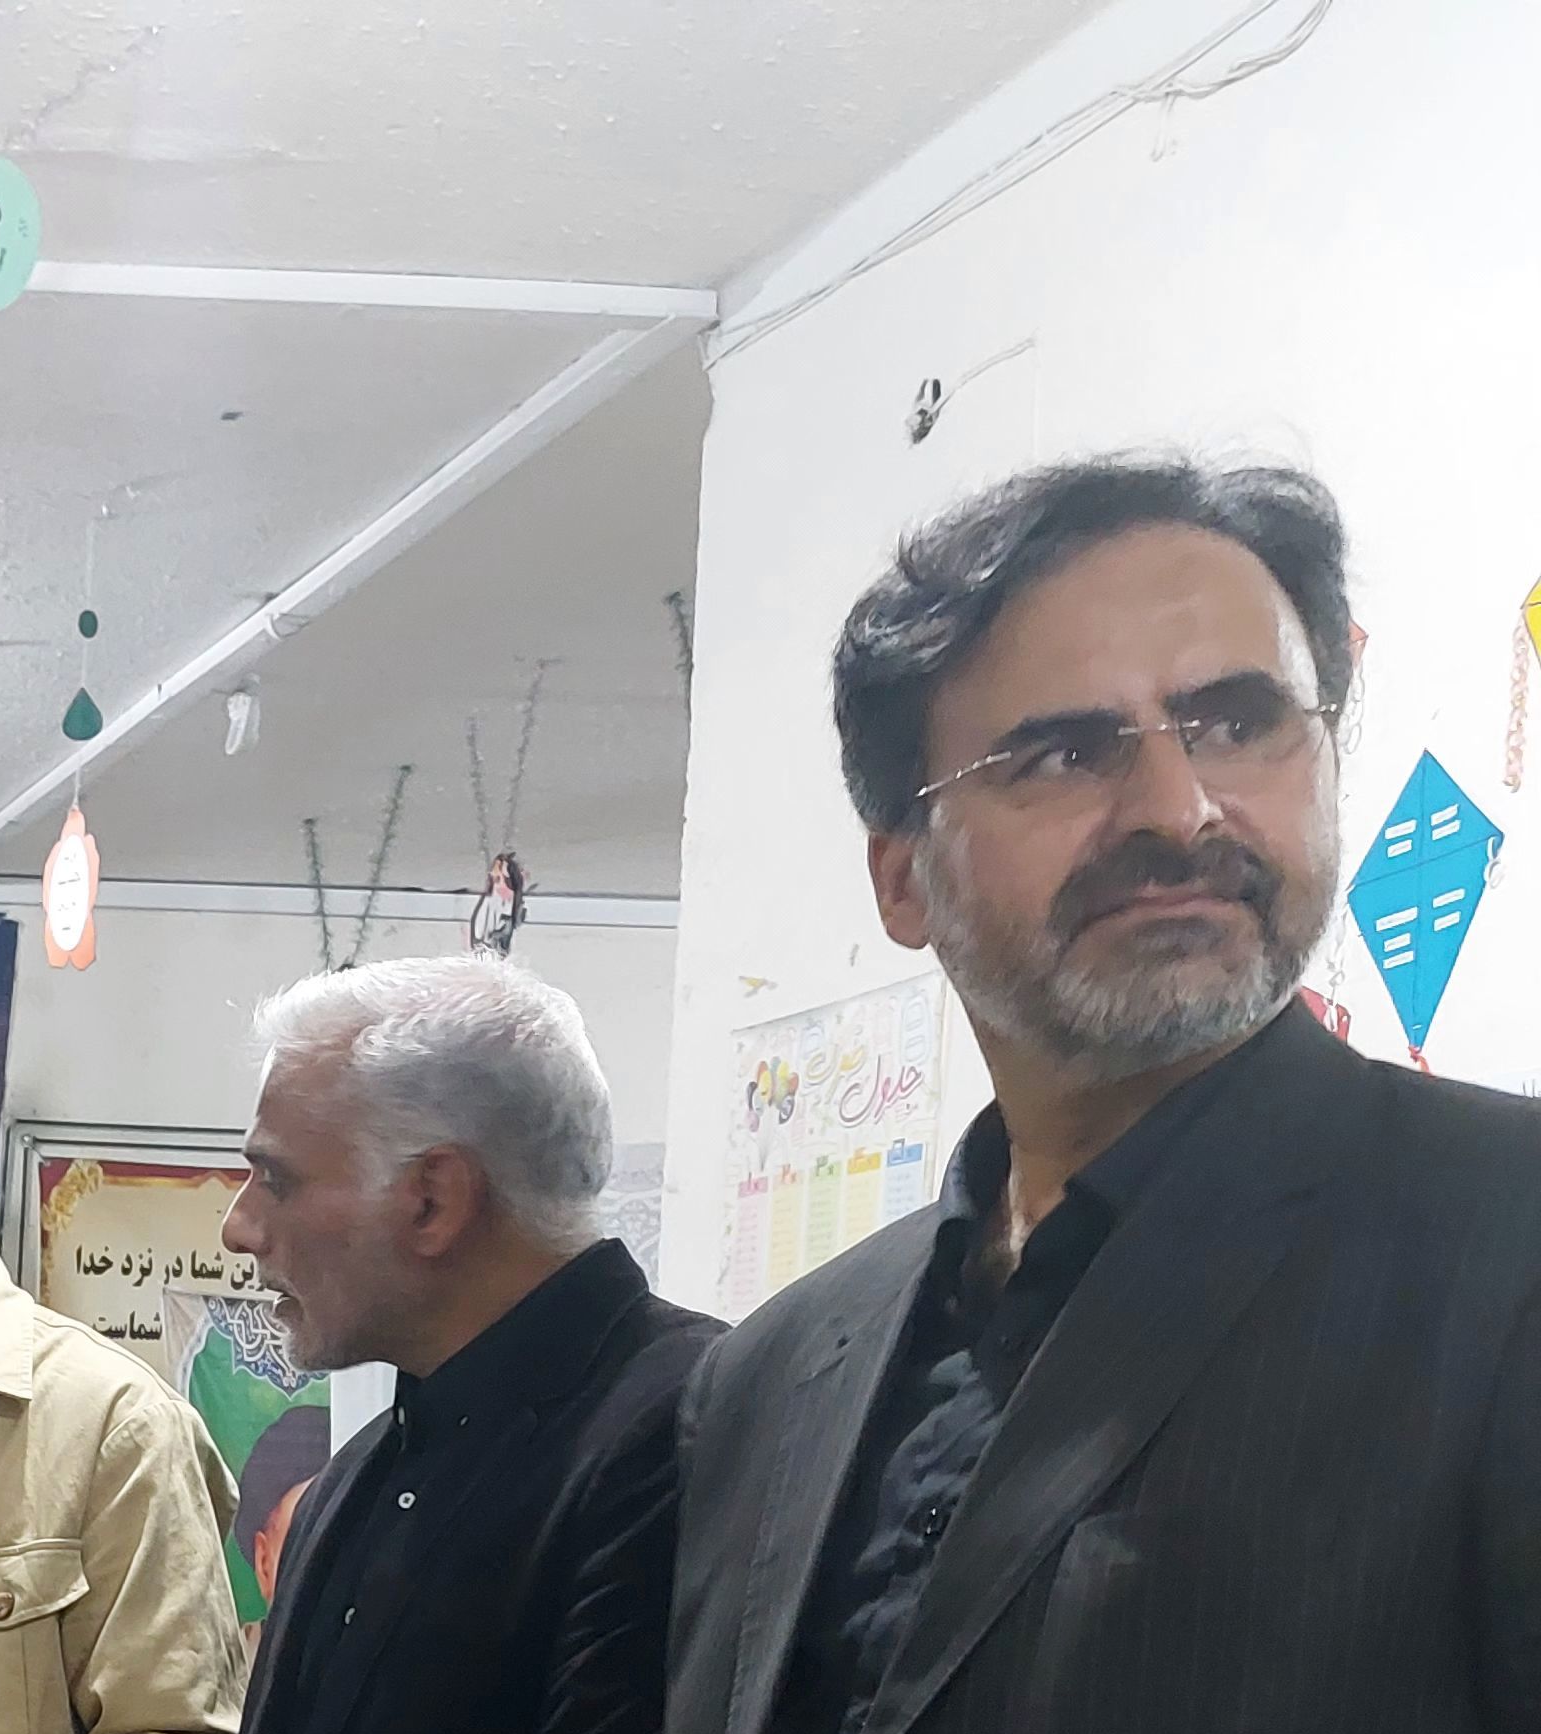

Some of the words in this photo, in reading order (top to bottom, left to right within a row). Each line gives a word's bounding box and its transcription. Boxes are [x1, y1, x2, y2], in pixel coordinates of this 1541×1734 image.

[838, 1054, 922, 1128] جدول
[76, 1245, 114, 1275] خدا
[121, 1248, 153, 1287] نزد
[164, 1256, 183, 1284] در
[190, 1250, 224, 1280] شما
[92, 1311, 163, 1340] شماست
